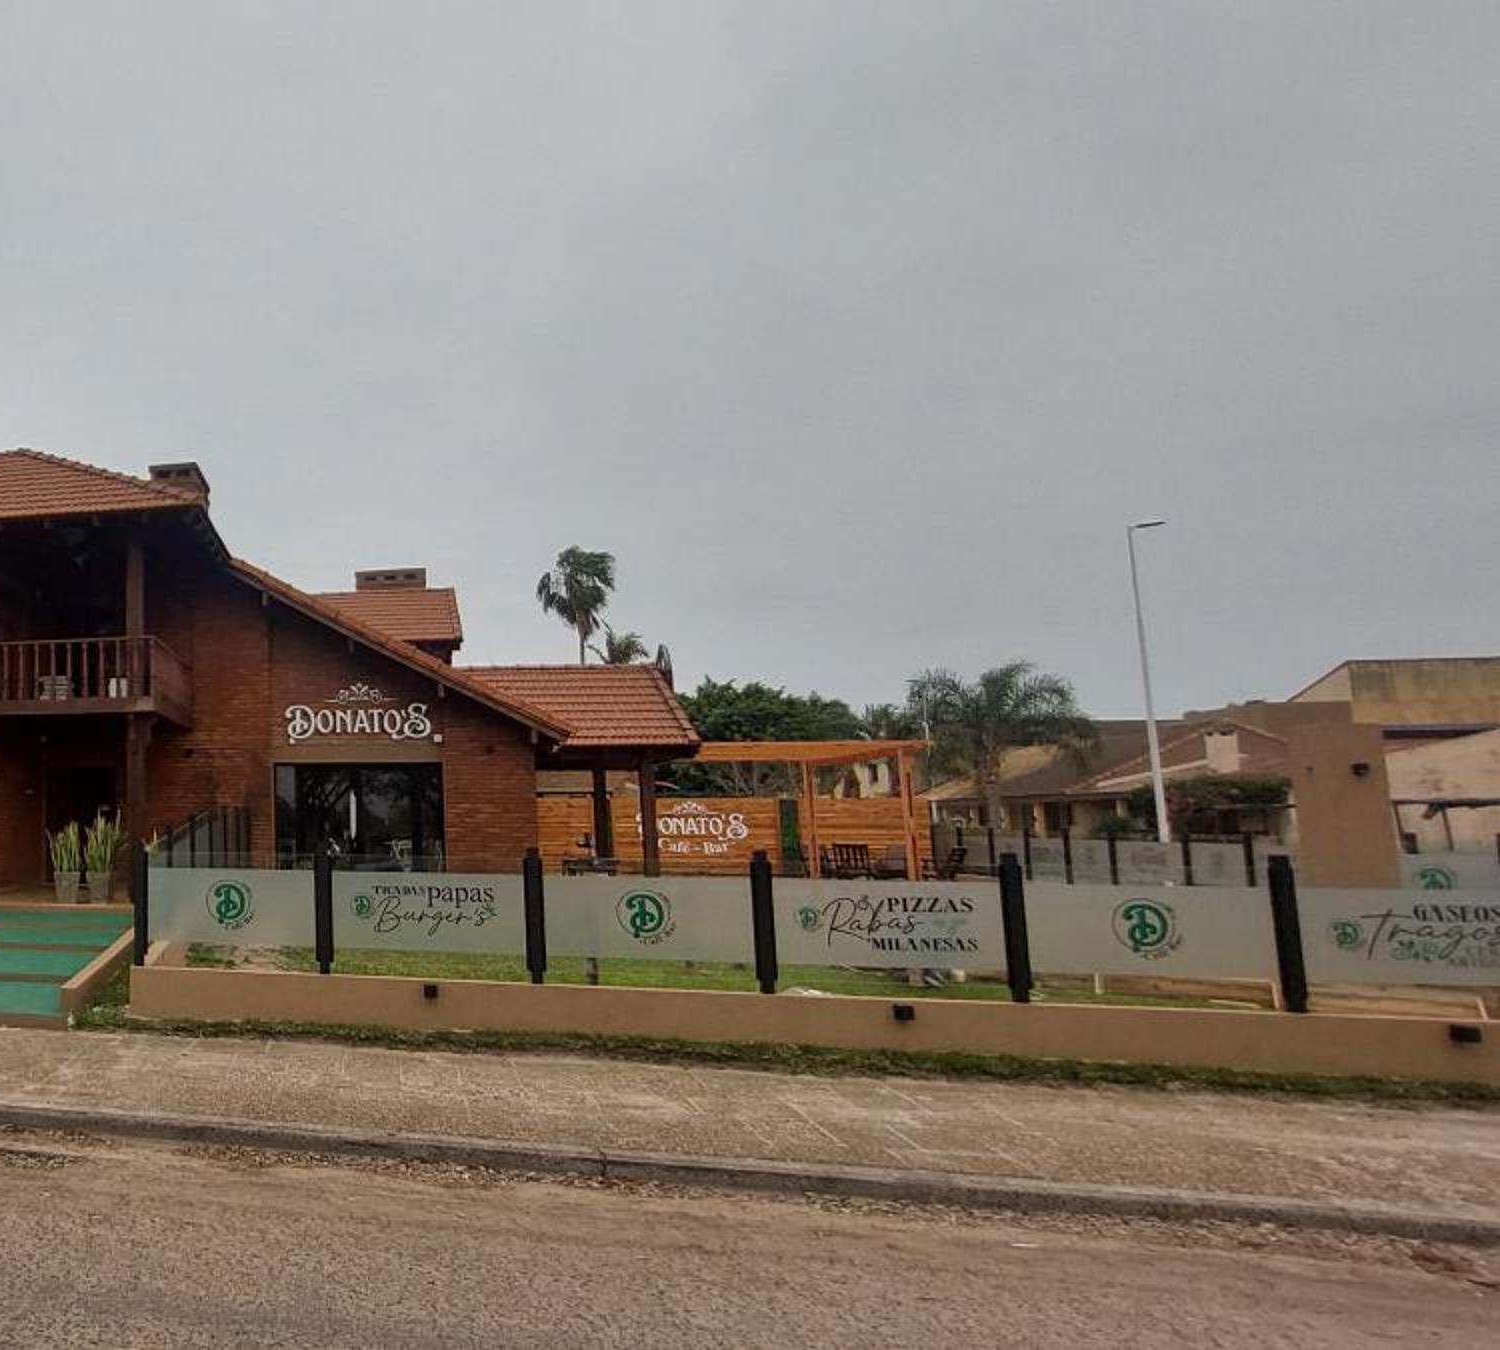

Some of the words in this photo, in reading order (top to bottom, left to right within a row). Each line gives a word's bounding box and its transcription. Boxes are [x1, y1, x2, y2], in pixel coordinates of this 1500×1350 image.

[636, 813, 749, 840] ONATO'S
[427, 885, 495, 908] papas
[886, 897, 975, 913] PIZZAS
[871, 937, 979, 951] MILANESAS
